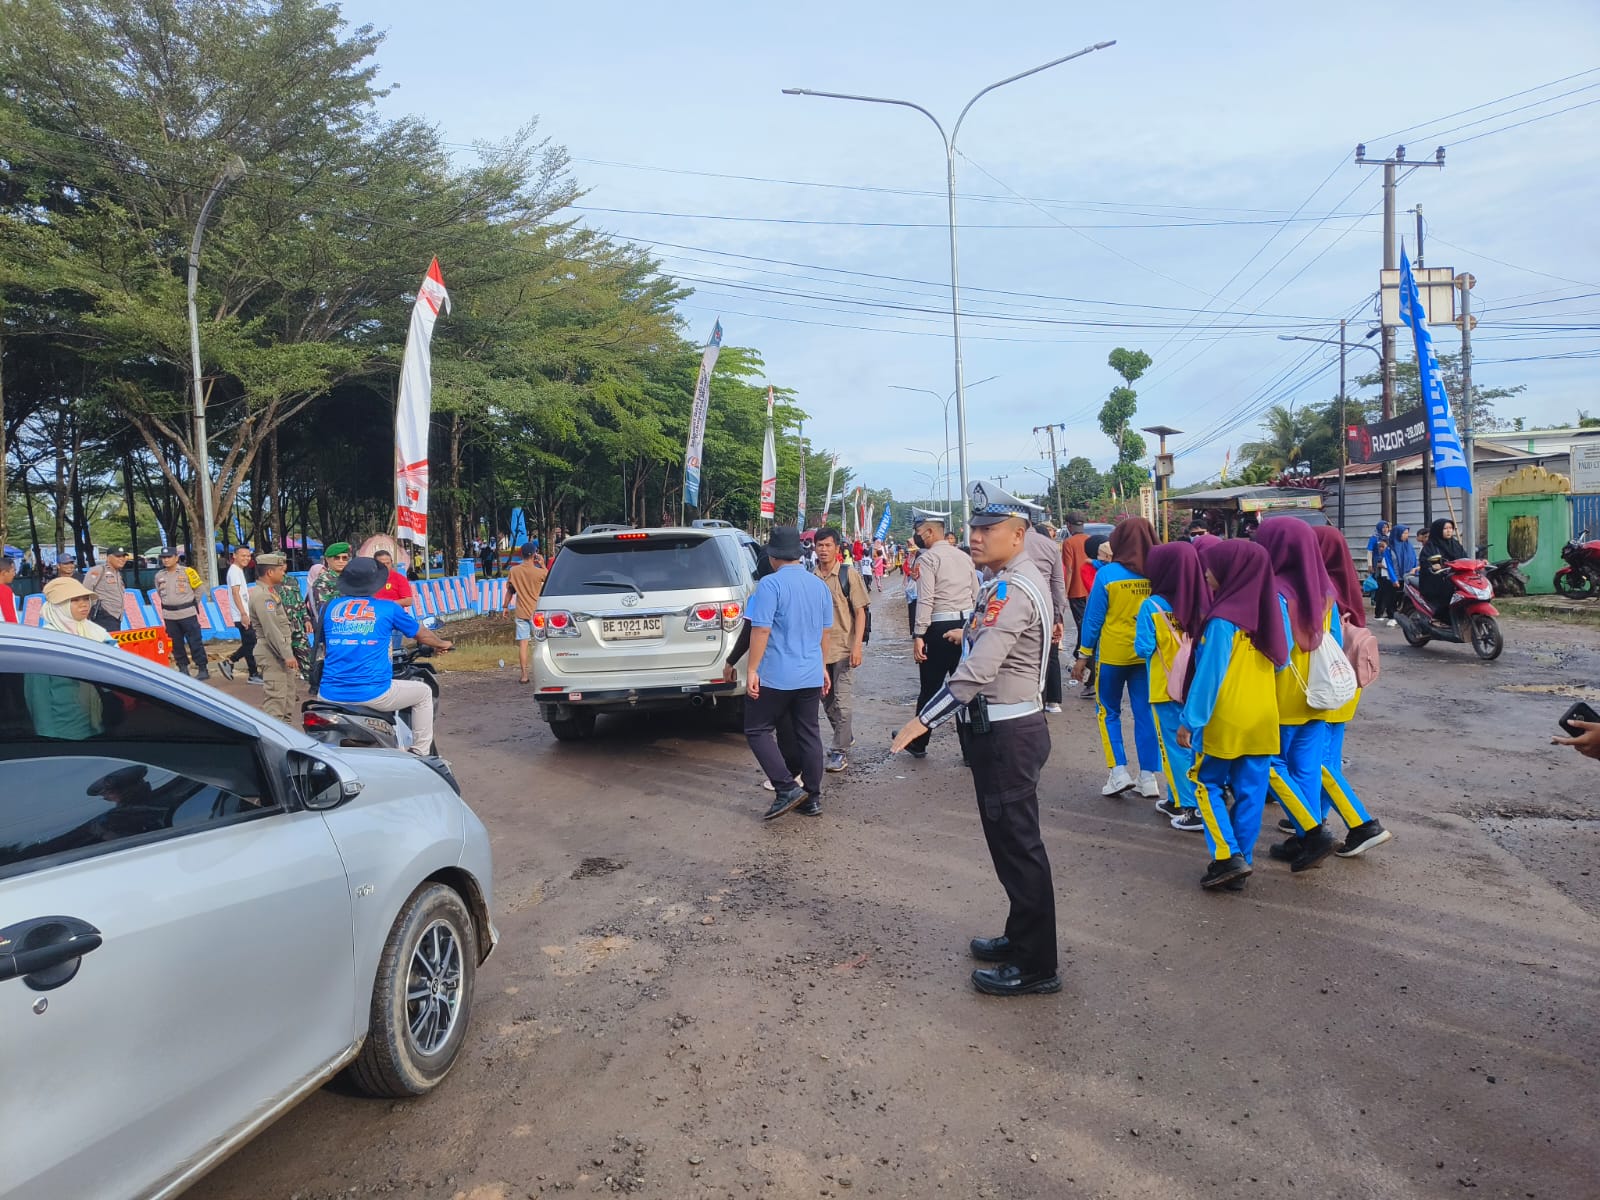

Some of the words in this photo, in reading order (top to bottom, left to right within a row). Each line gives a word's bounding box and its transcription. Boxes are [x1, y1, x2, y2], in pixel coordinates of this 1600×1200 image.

[1372, 430, 1405, 452] RAZOR
[603, 621, 615, 632] BE
[617, 620, 641, 631] 1921
[643, 619, 660, 630] ASC
